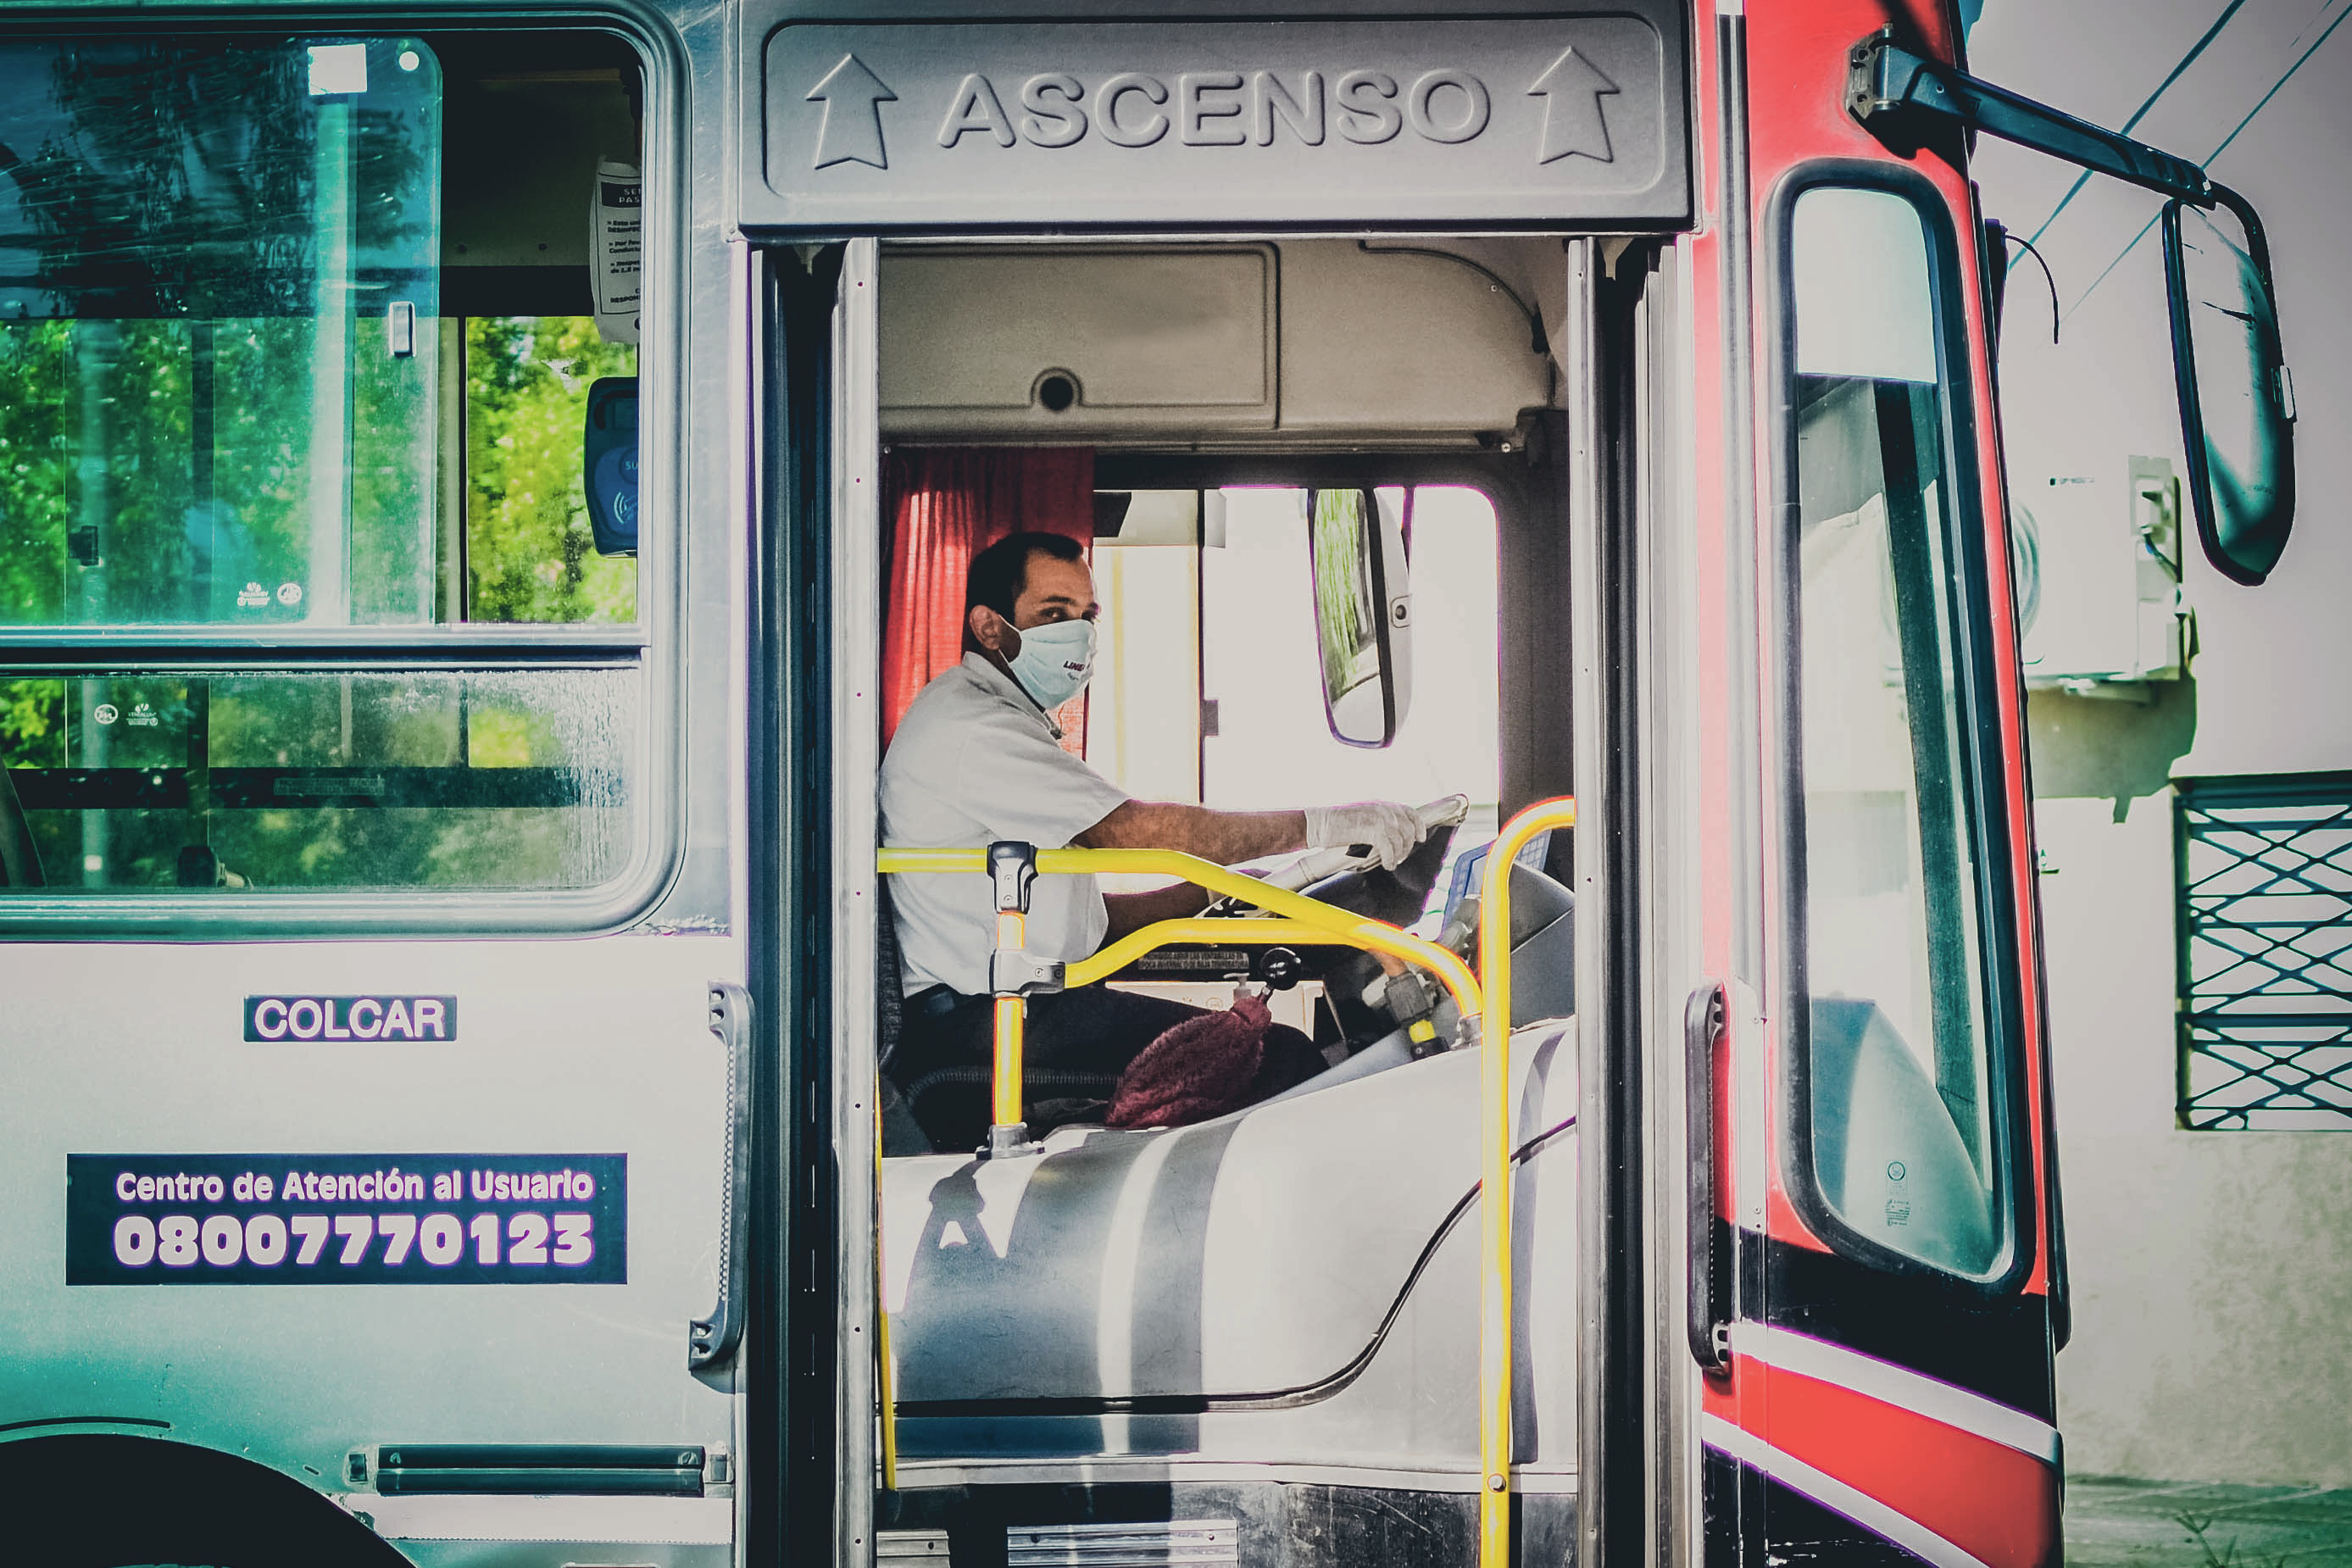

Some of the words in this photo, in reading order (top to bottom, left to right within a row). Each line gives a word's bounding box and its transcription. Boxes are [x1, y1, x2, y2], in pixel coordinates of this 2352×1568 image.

[937, 68, 1491, 149] ASCENSO
[254, 998, 445, 1038] COLCAR
[116, 1171, 224, 1200] Centro
[233, 1171, 273, 1200] de
[282, 1168, 424, 1200] Atención
[433, 1170, 462, 1200] al
[472, 1169, 593, 1200] Usuario
[114, 1214, 593, 1266] 08007770123
